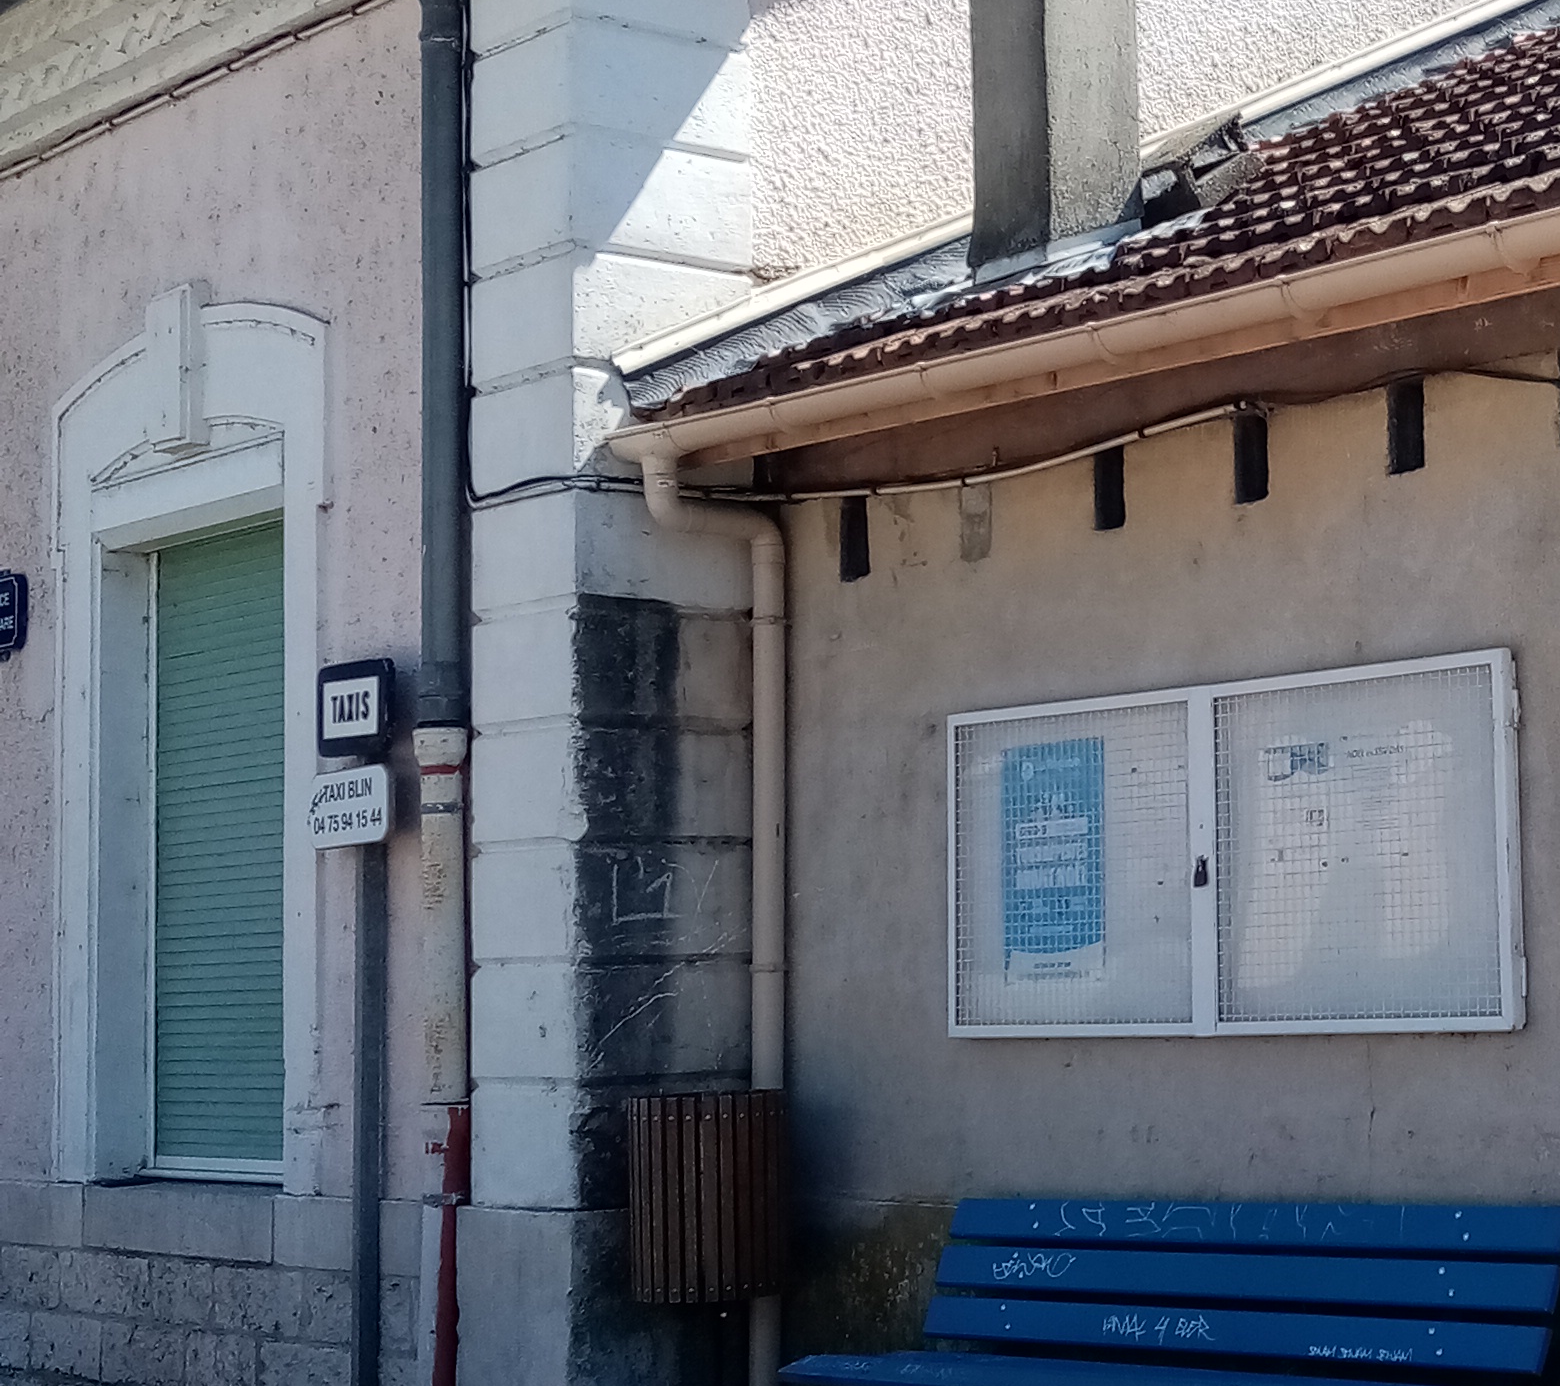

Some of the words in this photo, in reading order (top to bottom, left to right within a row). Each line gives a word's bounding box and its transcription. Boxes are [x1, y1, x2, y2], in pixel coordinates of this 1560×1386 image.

[330, 690, 370, 724] TAXIS
[322, 781, 346, 804] TAXI
[347, 777, 373, 798] BLIN
[313, 813, 326, 835] 04
[327, 815, 340, 832] 75
[341, 812, 353, 831] 94
[356, 810, 368, 829] 15
[370, 807, 382, 826] 44
